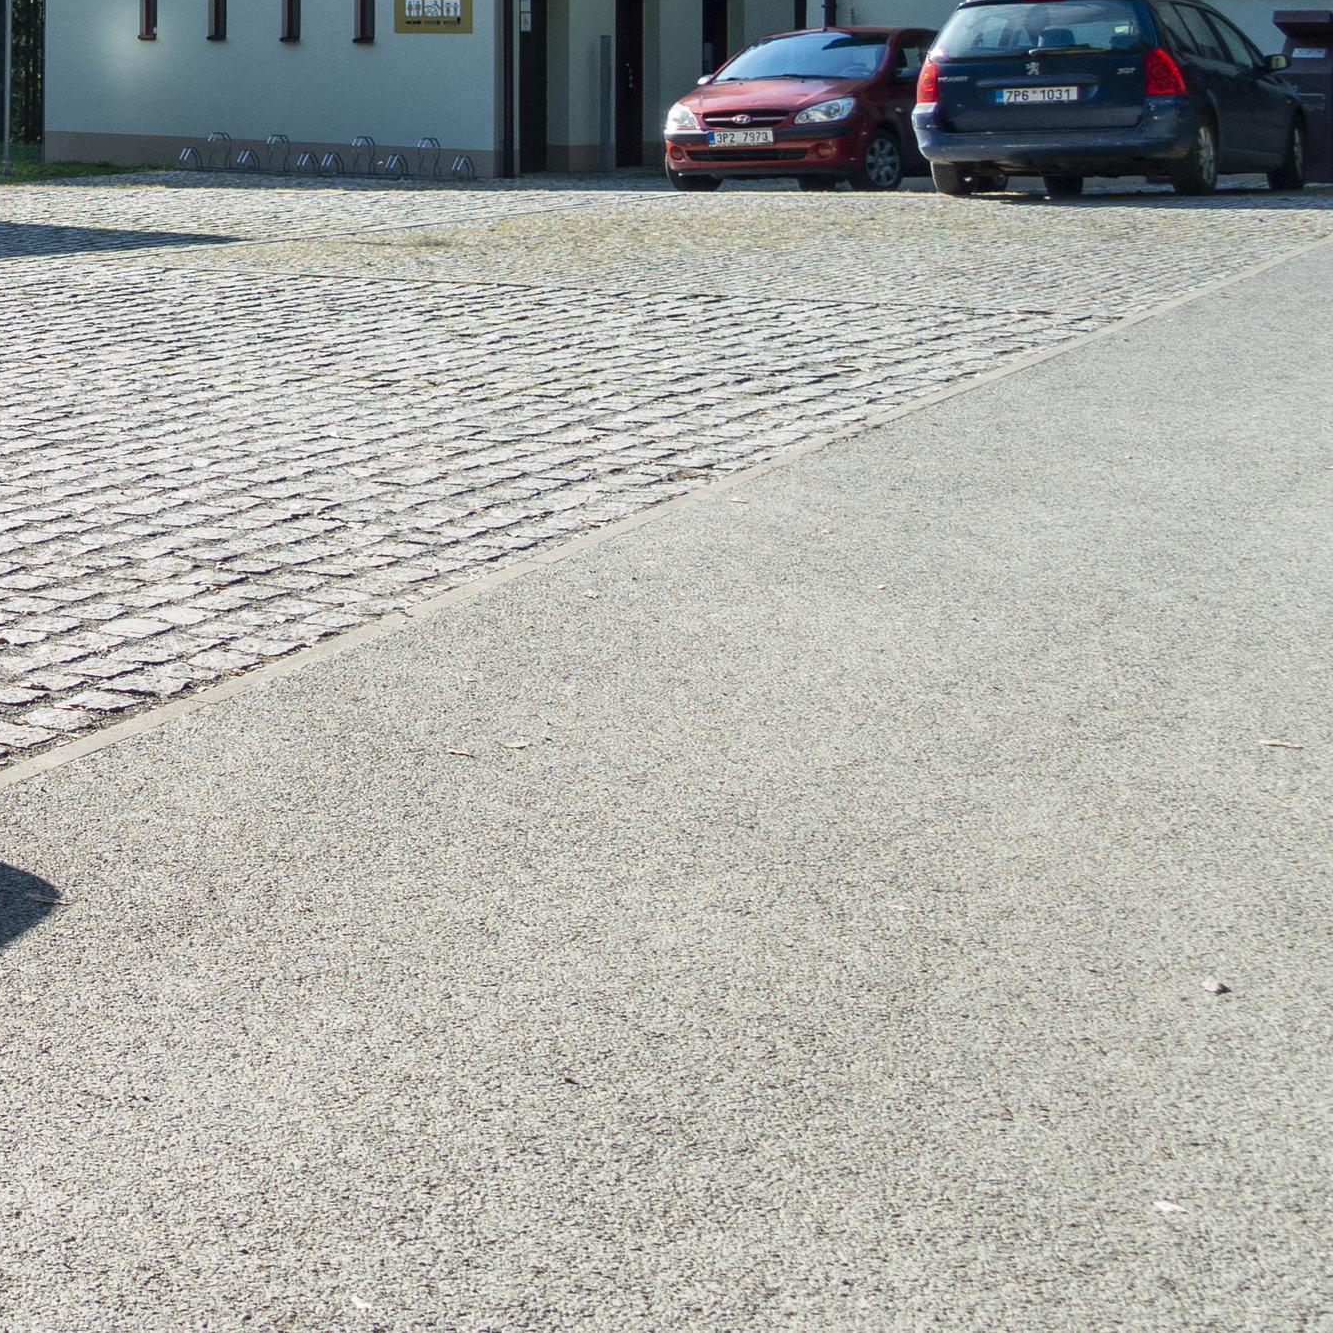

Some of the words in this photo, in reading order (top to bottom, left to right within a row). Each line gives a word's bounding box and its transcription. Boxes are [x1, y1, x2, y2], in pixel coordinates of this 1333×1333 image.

[1006, 90, 1029, 102] 7P6
[1040, 88, 1070, 100] 1031
[716, 133, 735, 143] 3P2
[743, 132, 768, 142] 7973
